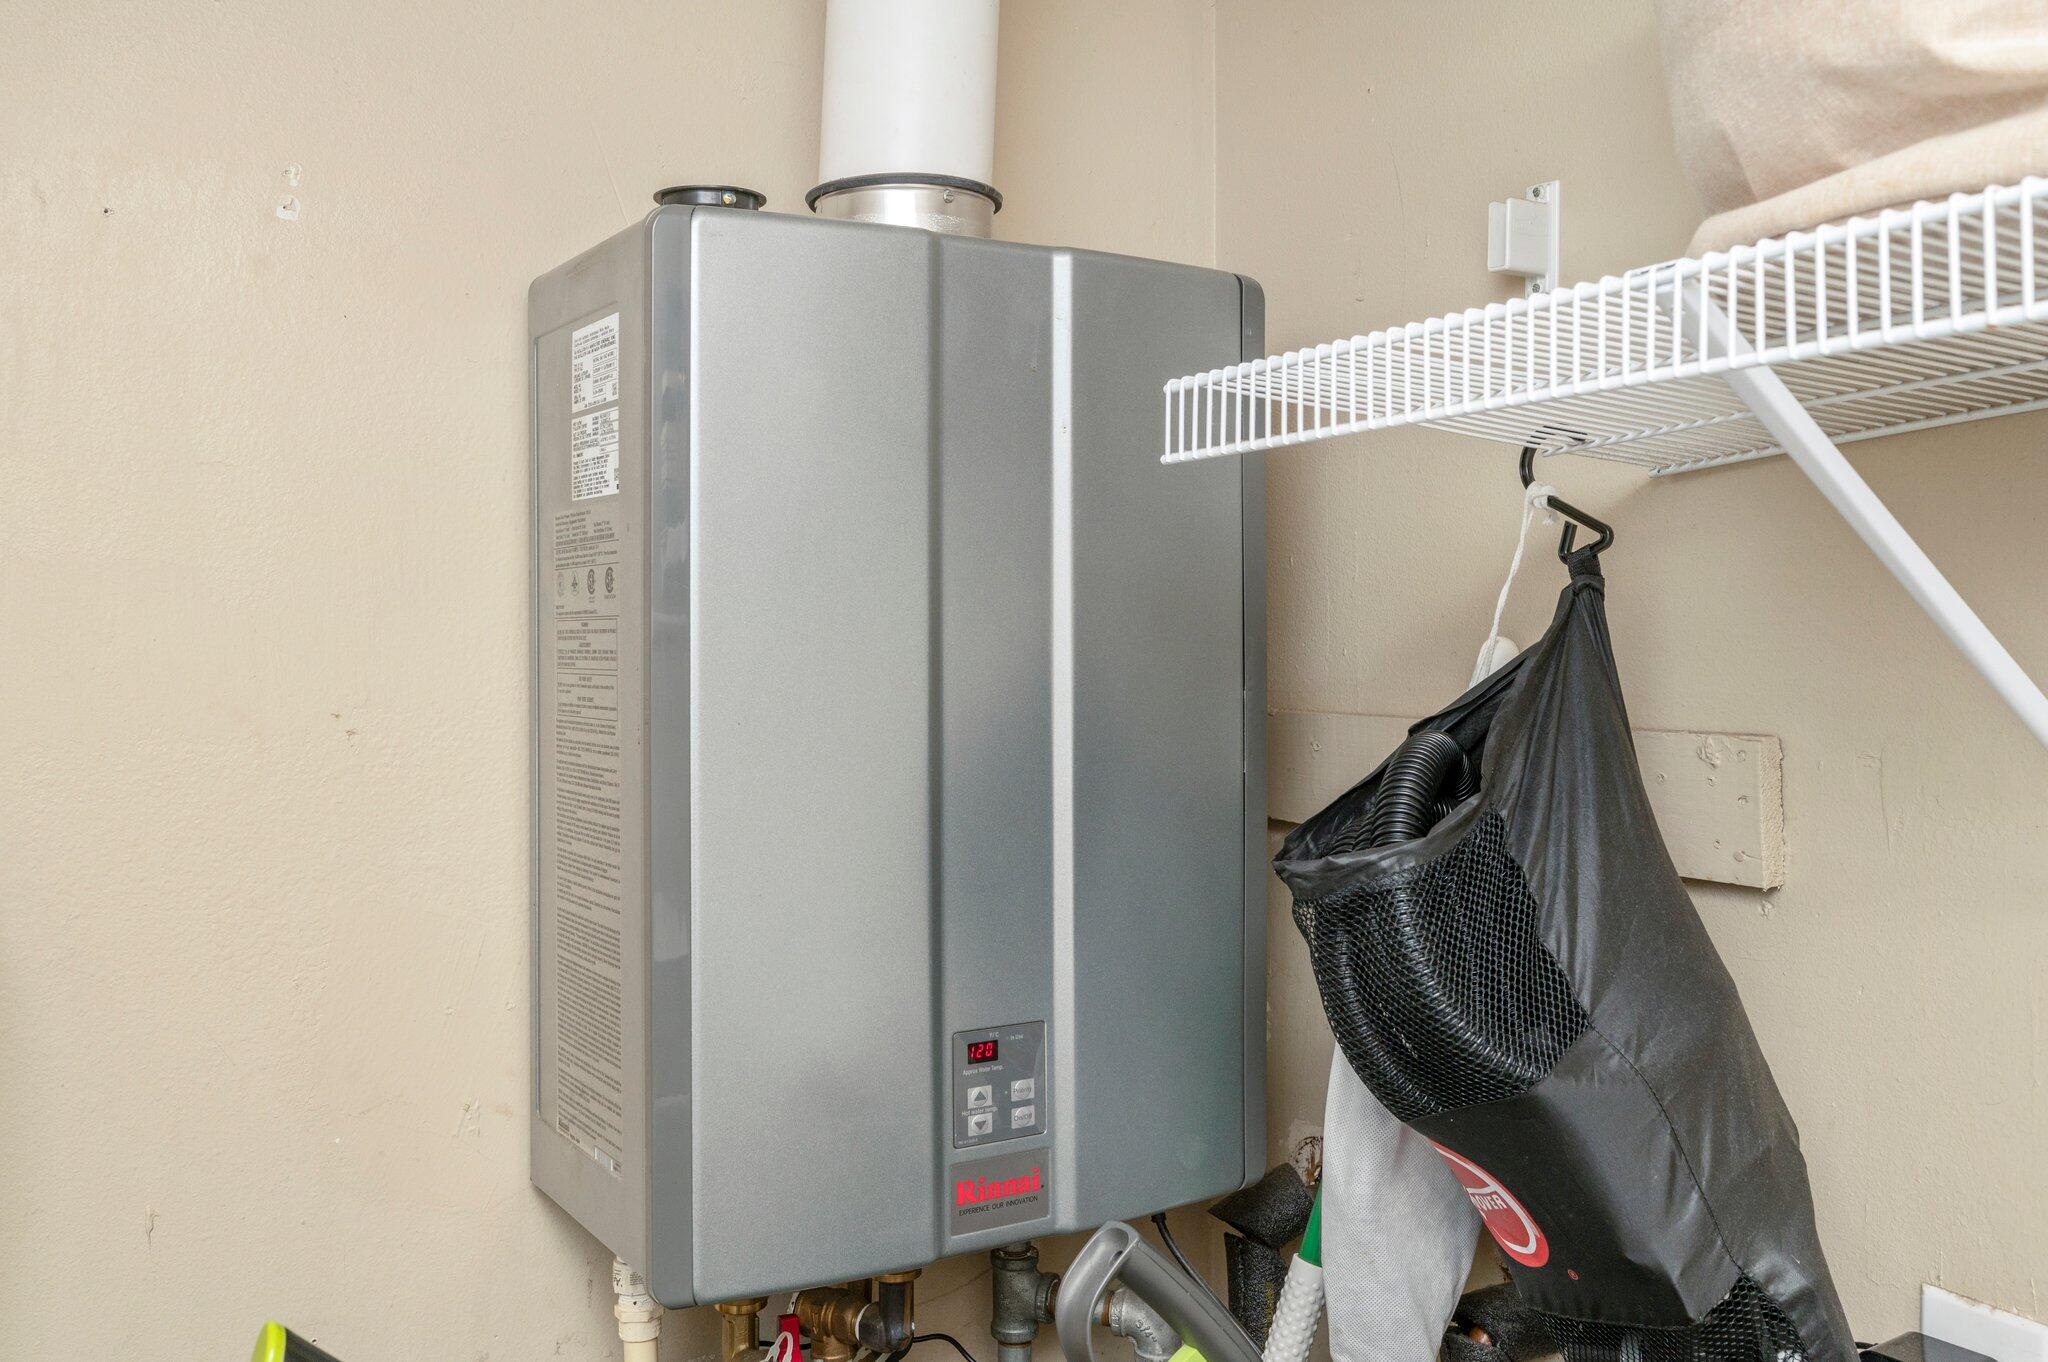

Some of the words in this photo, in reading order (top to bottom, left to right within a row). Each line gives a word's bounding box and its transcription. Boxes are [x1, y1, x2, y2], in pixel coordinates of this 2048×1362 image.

[970, 1042, 993, 1058] 120
[955, 1167, 1041, 1206] Rinnai
[958, 1204, 990, 1216] EXPERIENCE
[991, 1201, 1005, 1210] OUR
[1005, 1196, 1038, 1208] INNOVATION
